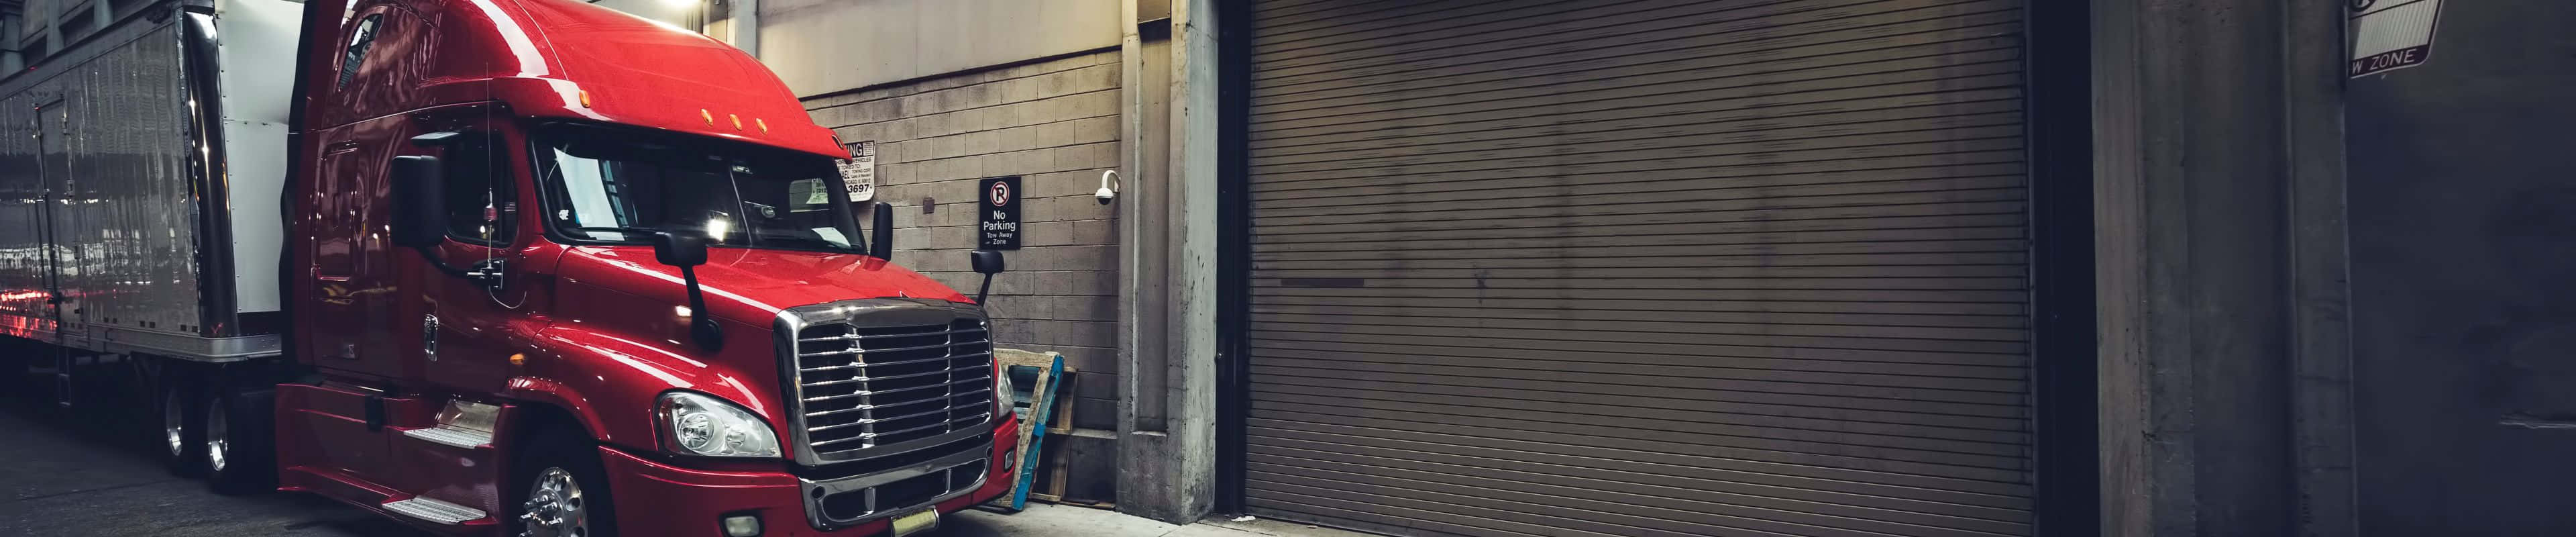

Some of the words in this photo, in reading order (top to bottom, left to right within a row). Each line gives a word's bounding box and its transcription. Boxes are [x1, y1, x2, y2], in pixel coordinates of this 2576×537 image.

[2369, 48, 2418, 70] ZONE
[994, 210, 1006, 220] No
[983, 220, 1016, 232] Parking
